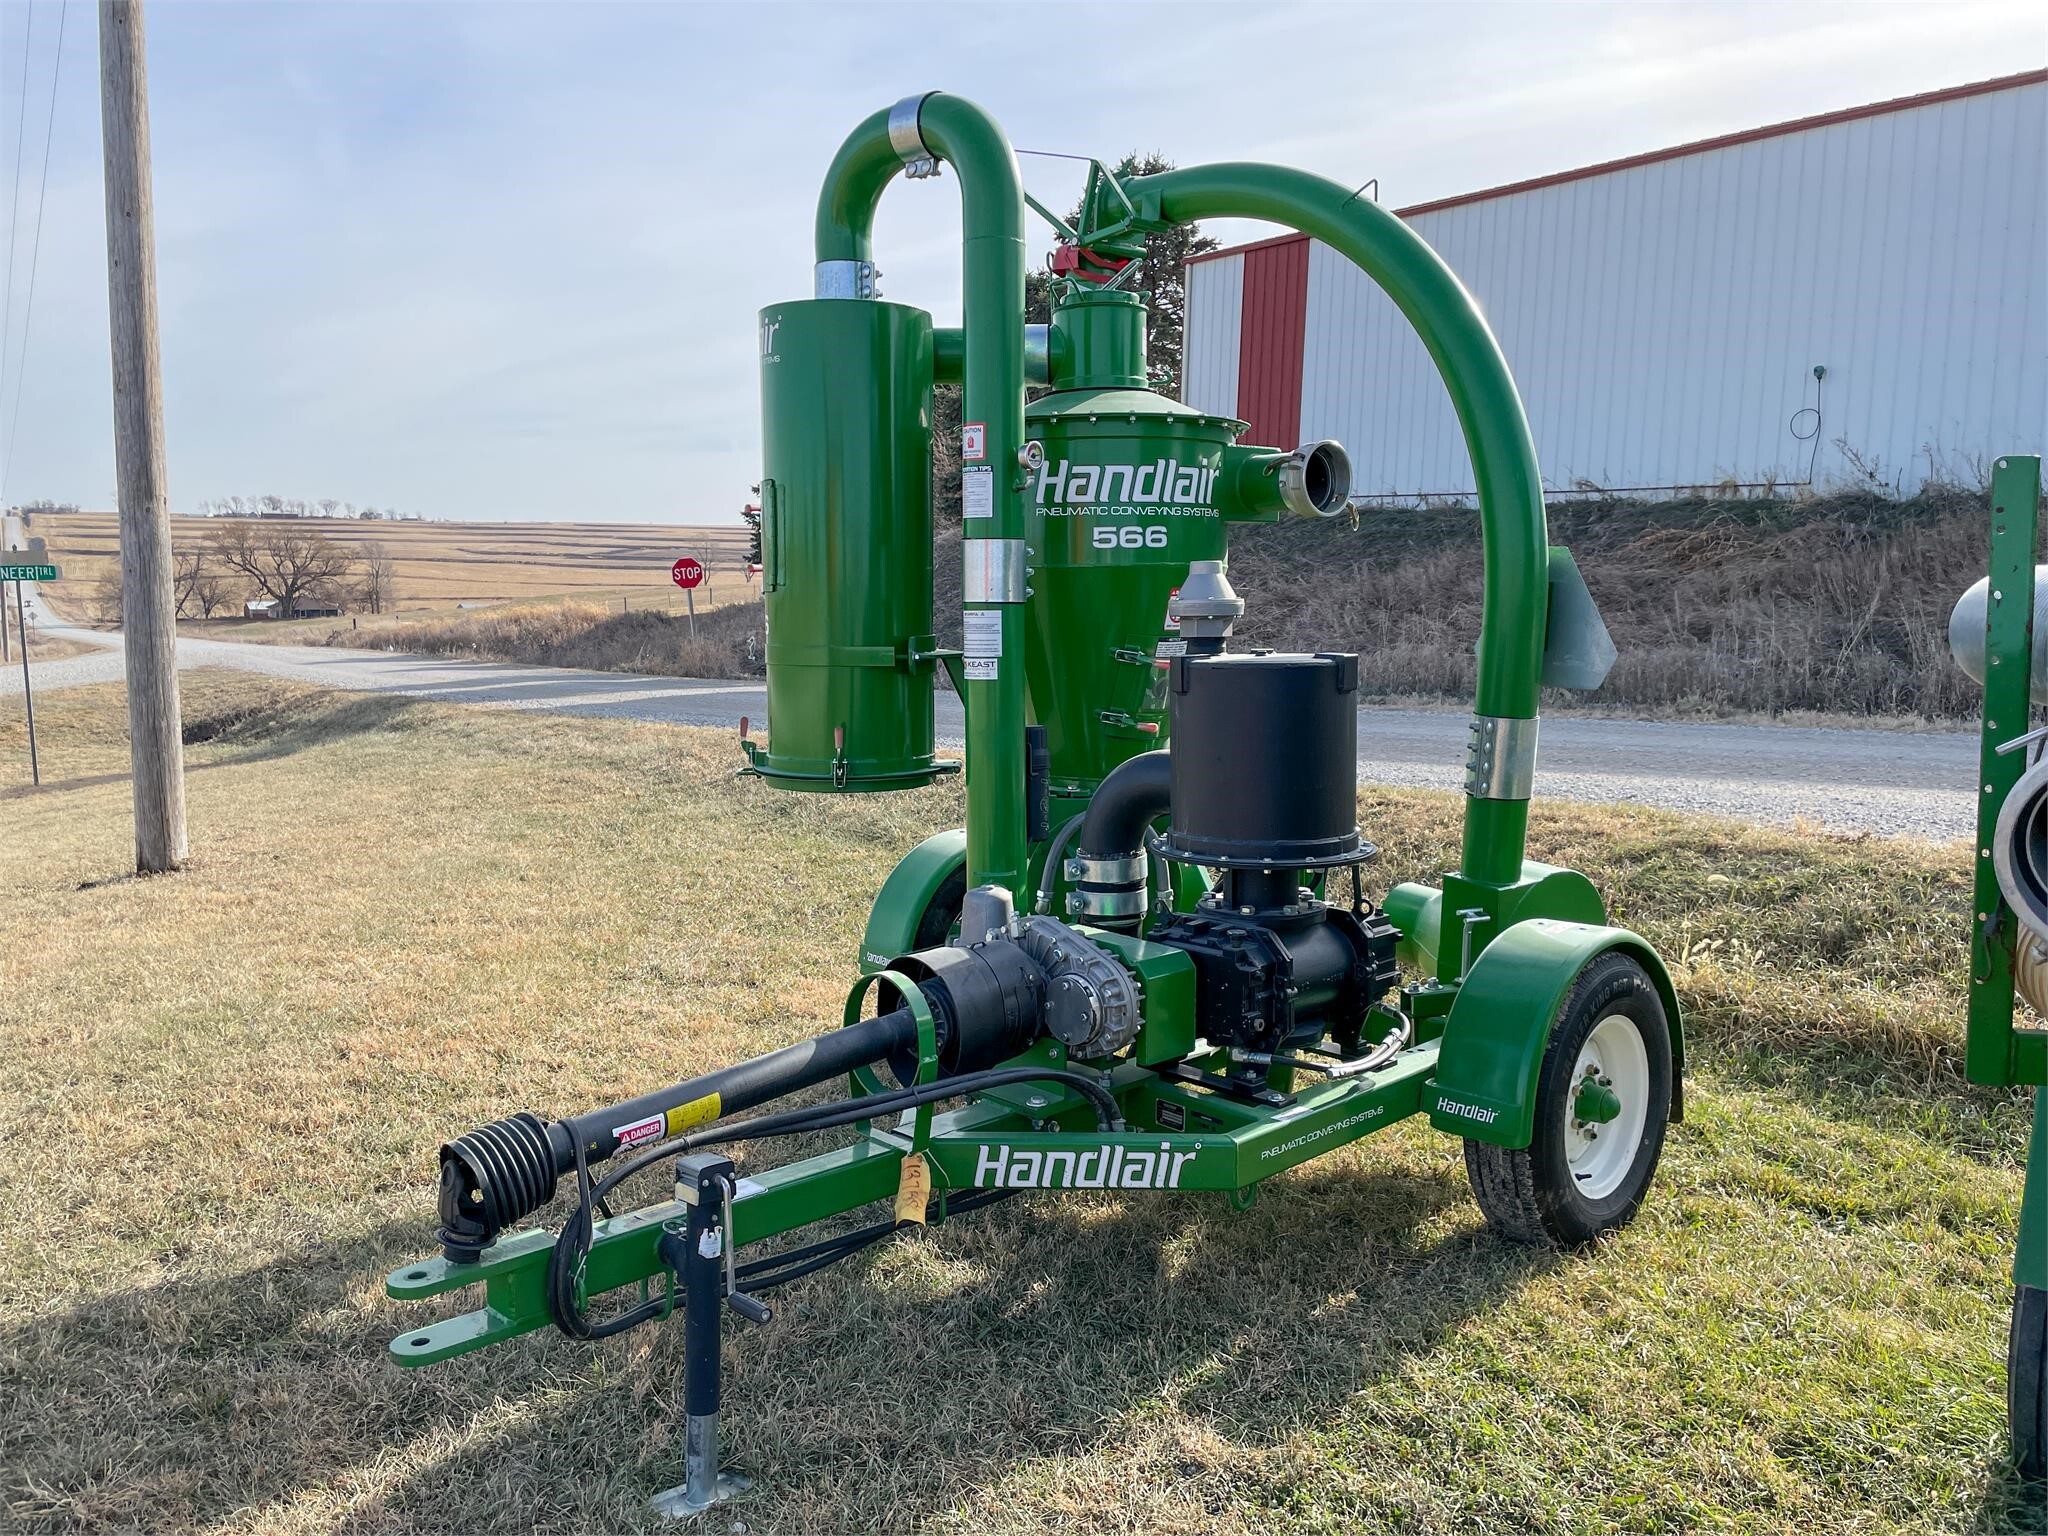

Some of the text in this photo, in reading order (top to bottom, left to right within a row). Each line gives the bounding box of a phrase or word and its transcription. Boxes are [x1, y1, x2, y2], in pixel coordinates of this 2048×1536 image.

[1036, 458, 1220, 504] Handlair
[1036, 506, 1220, 517] PNEUMATIC CONVEYING SYSTEMS
[1092, 525, 1168, 549] 566
[39, 566, 54, 576] TRL
[673, 566, 701, 580] STOP
[1437, 1096, 1499, 1124] Handlair
[630, 1123, 660, 1140] DANGER
[1261, 1105, 1384, 1160] PNEUMATIC CONVEYING SYSTEMS
[974, 1141, 1197, 1188] Handlair
